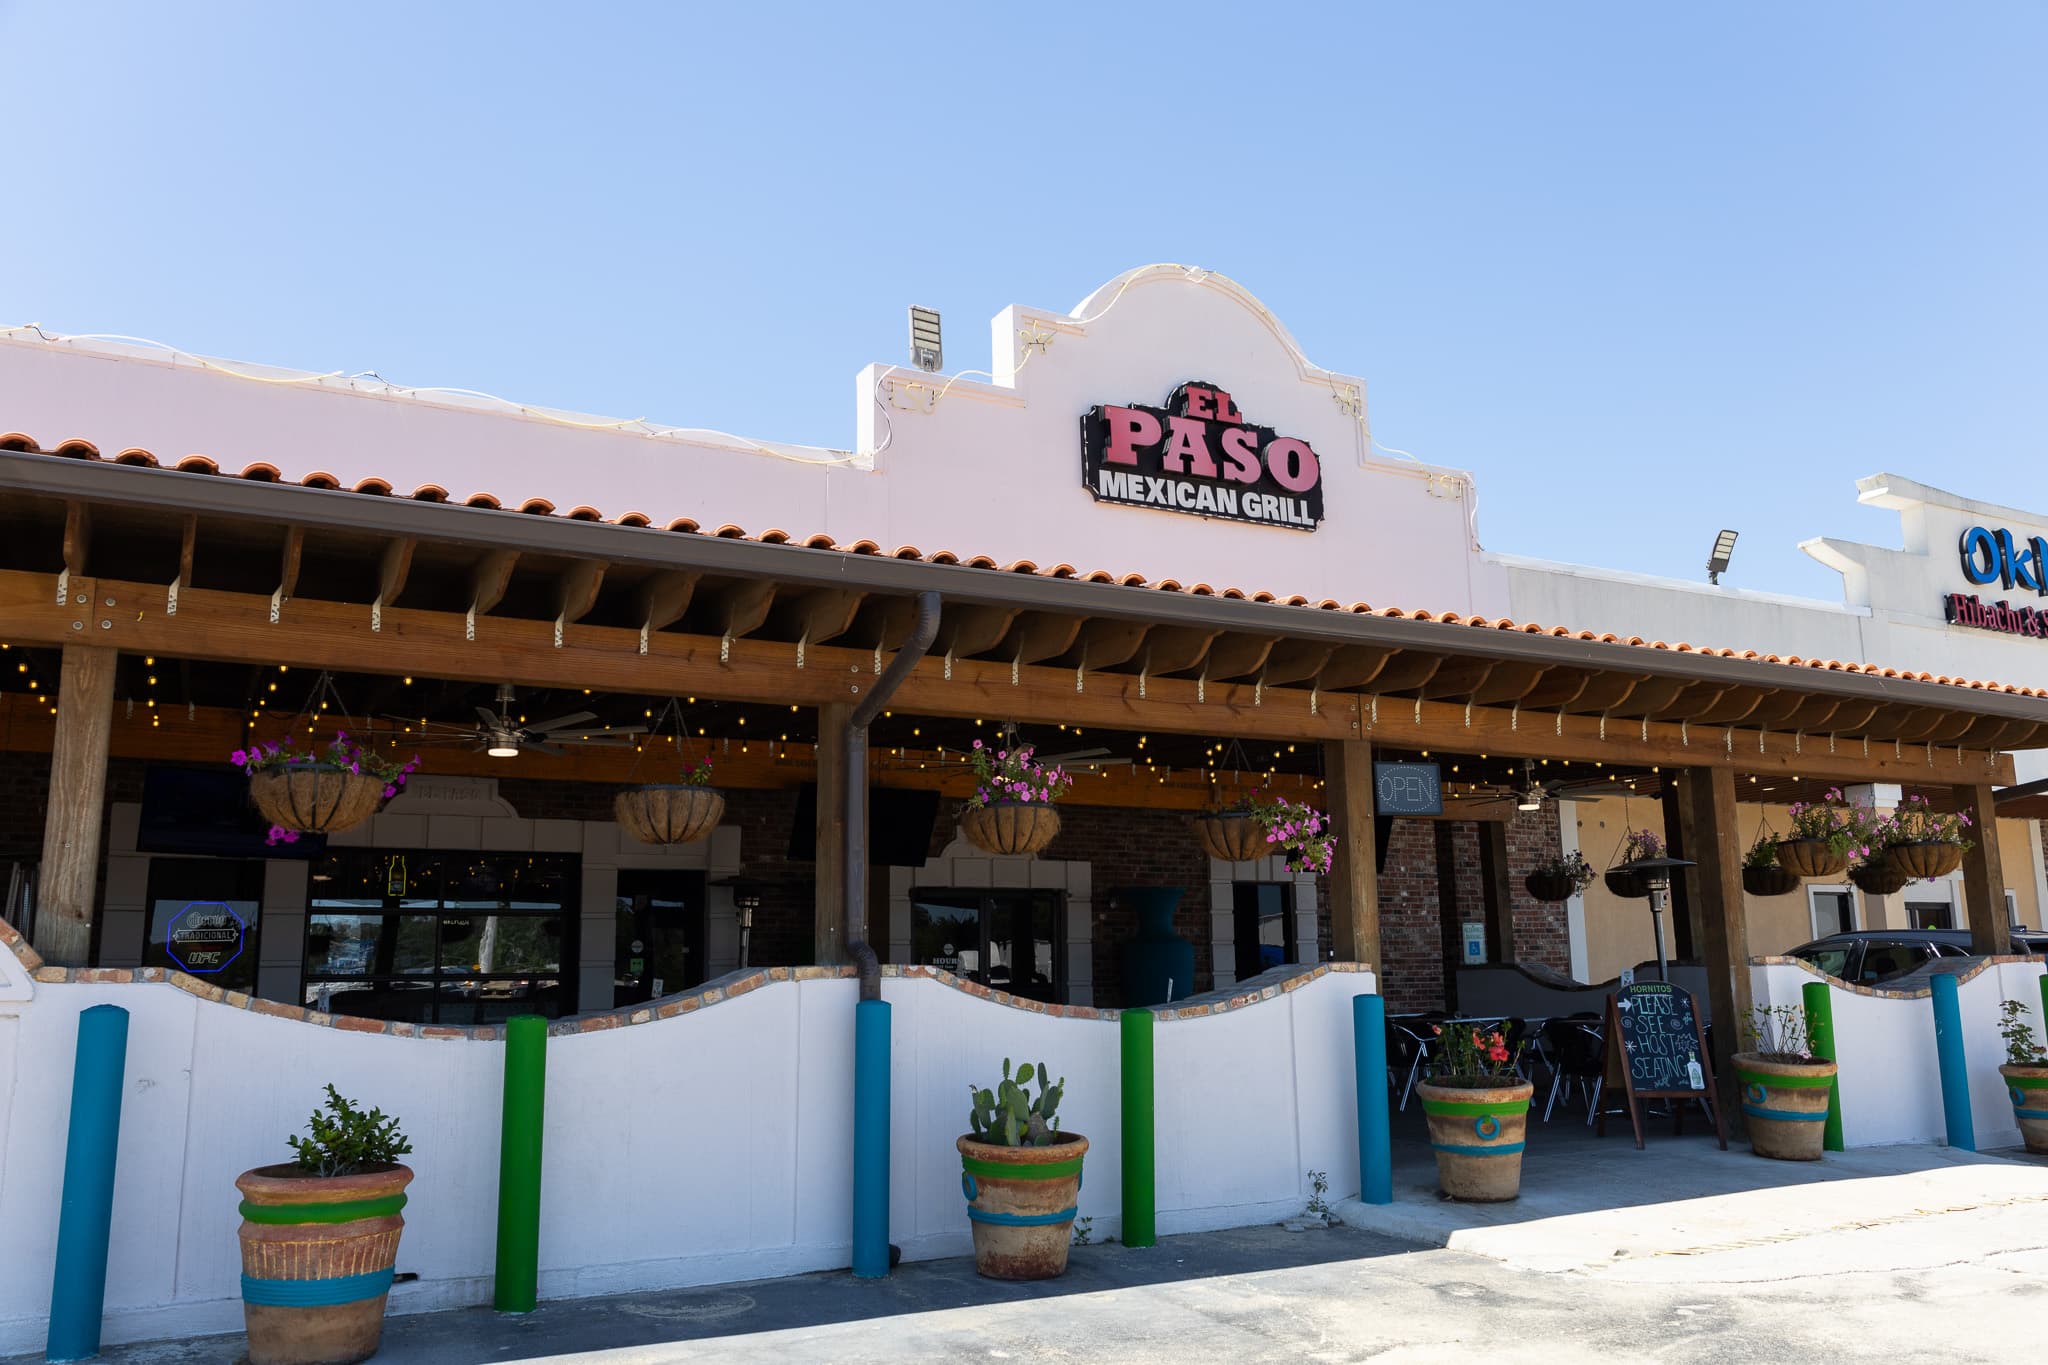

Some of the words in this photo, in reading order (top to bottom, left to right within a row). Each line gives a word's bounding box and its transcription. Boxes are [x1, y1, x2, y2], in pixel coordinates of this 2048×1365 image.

[1185, 384, 1242, 424] EL
[1103, 404, 1320, 493] PASO
[1099, 469, 1238, 515] MEXICAN
[1242, 491, 1315, 526] GRILL
[1949, 592, 2024, 634] Hibachi
[1380, 776, 1433, 801] OPEN
[179, 930, 231, 941] TRADICIONAL
[187, 952, 221, 964] UFC
[1629, 985, 1672, 993] HORNITOS
[1630, 995, 1678, 1015] PLEASE
[1635, 1015, 1666, 1034] SEE
[1637, 1033, 1678, 1055] HOST
[1631, 1055, 1688, 1079] SEATING
